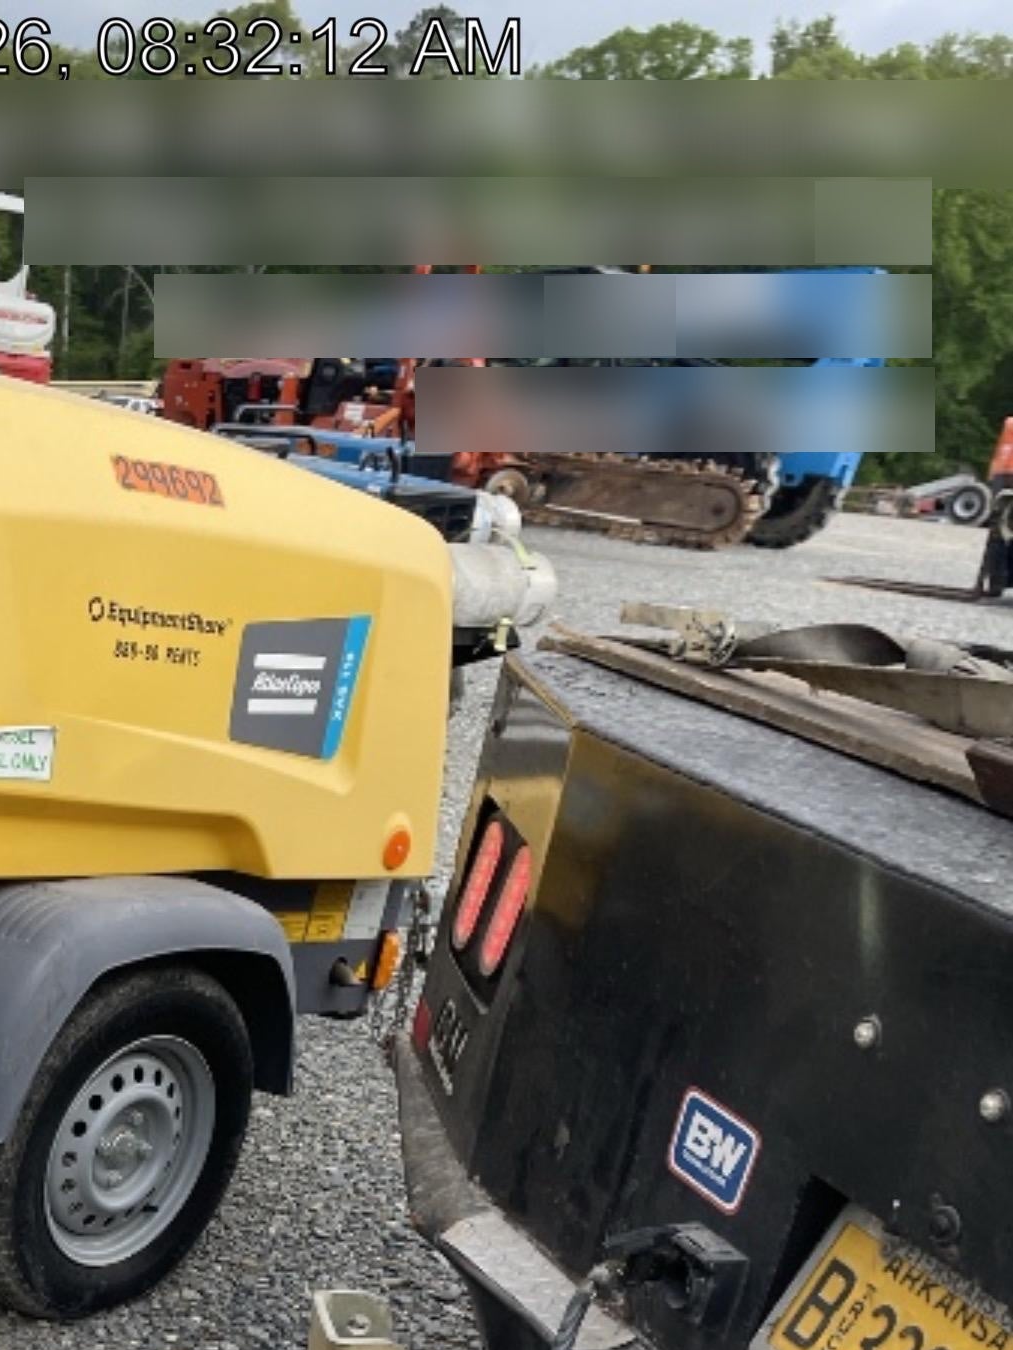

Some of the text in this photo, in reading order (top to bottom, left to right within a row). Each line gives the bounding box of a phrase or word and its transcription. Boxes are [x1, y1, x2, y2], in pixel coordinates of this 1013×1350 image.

[108, 455, 225, 507] 299692
[107, 601, 226, 636] EquipmentShare
[782, 1258, 857, 1350] B
